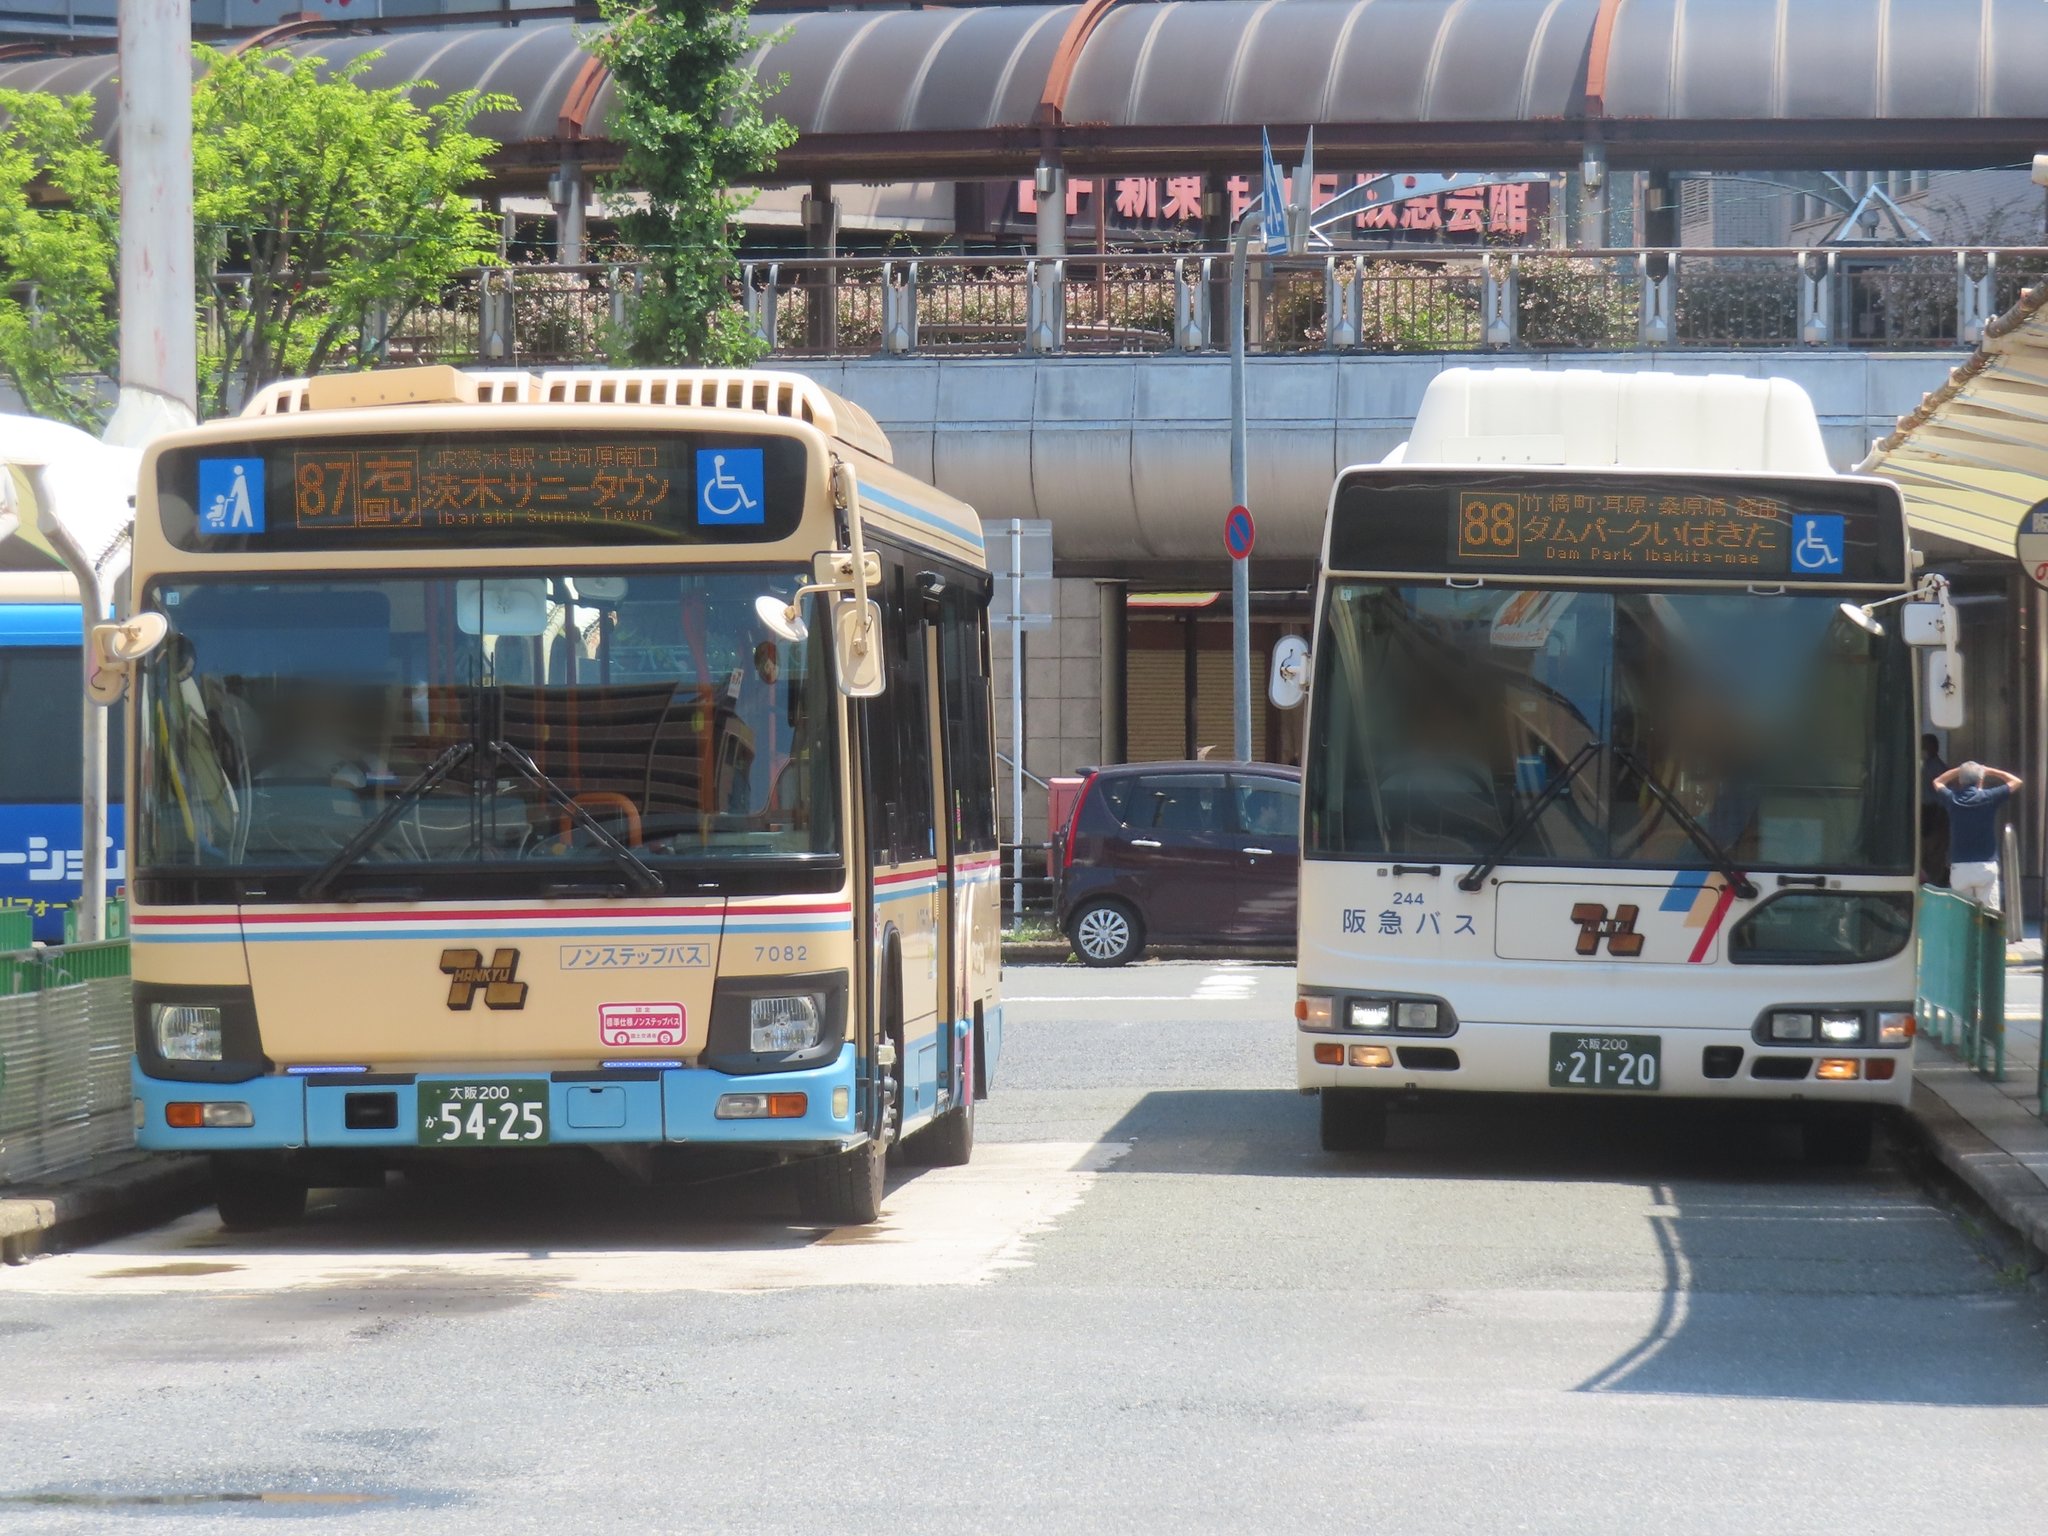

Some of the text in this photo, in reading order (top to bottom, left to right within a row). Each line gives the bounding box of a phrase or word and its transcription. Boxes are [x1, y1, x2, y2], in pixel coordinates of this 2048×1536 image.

[299, 462, 350, 516] 87
[421, 468, 669, 509] 茨木サニータウン
[438, 506, 653, 525] Ibaraki Sunny Town
[1465, 501, 1515, 546] 88
[1523, 516, 1776, 549] ダムパークいばきた
[1546, 547, 1759, 564] Dam Park Ibakita-mae
[1393, 891, 1424, 905] 244
[1343, 909, 1475, 935] 阪急バス
[568, 946, 702, 966] ノンステップバス
[754, 946, 808, 962] 7082
[454, 967, 510, 982] HANKYU
[1577, 1038, 1628, 1051] 大阪200
[1568, 1051, 1656, 1086] 21-20
[449, 1086, 510, 1100] 大阪200
[425, 1102, 543, 1140] か 54-25
